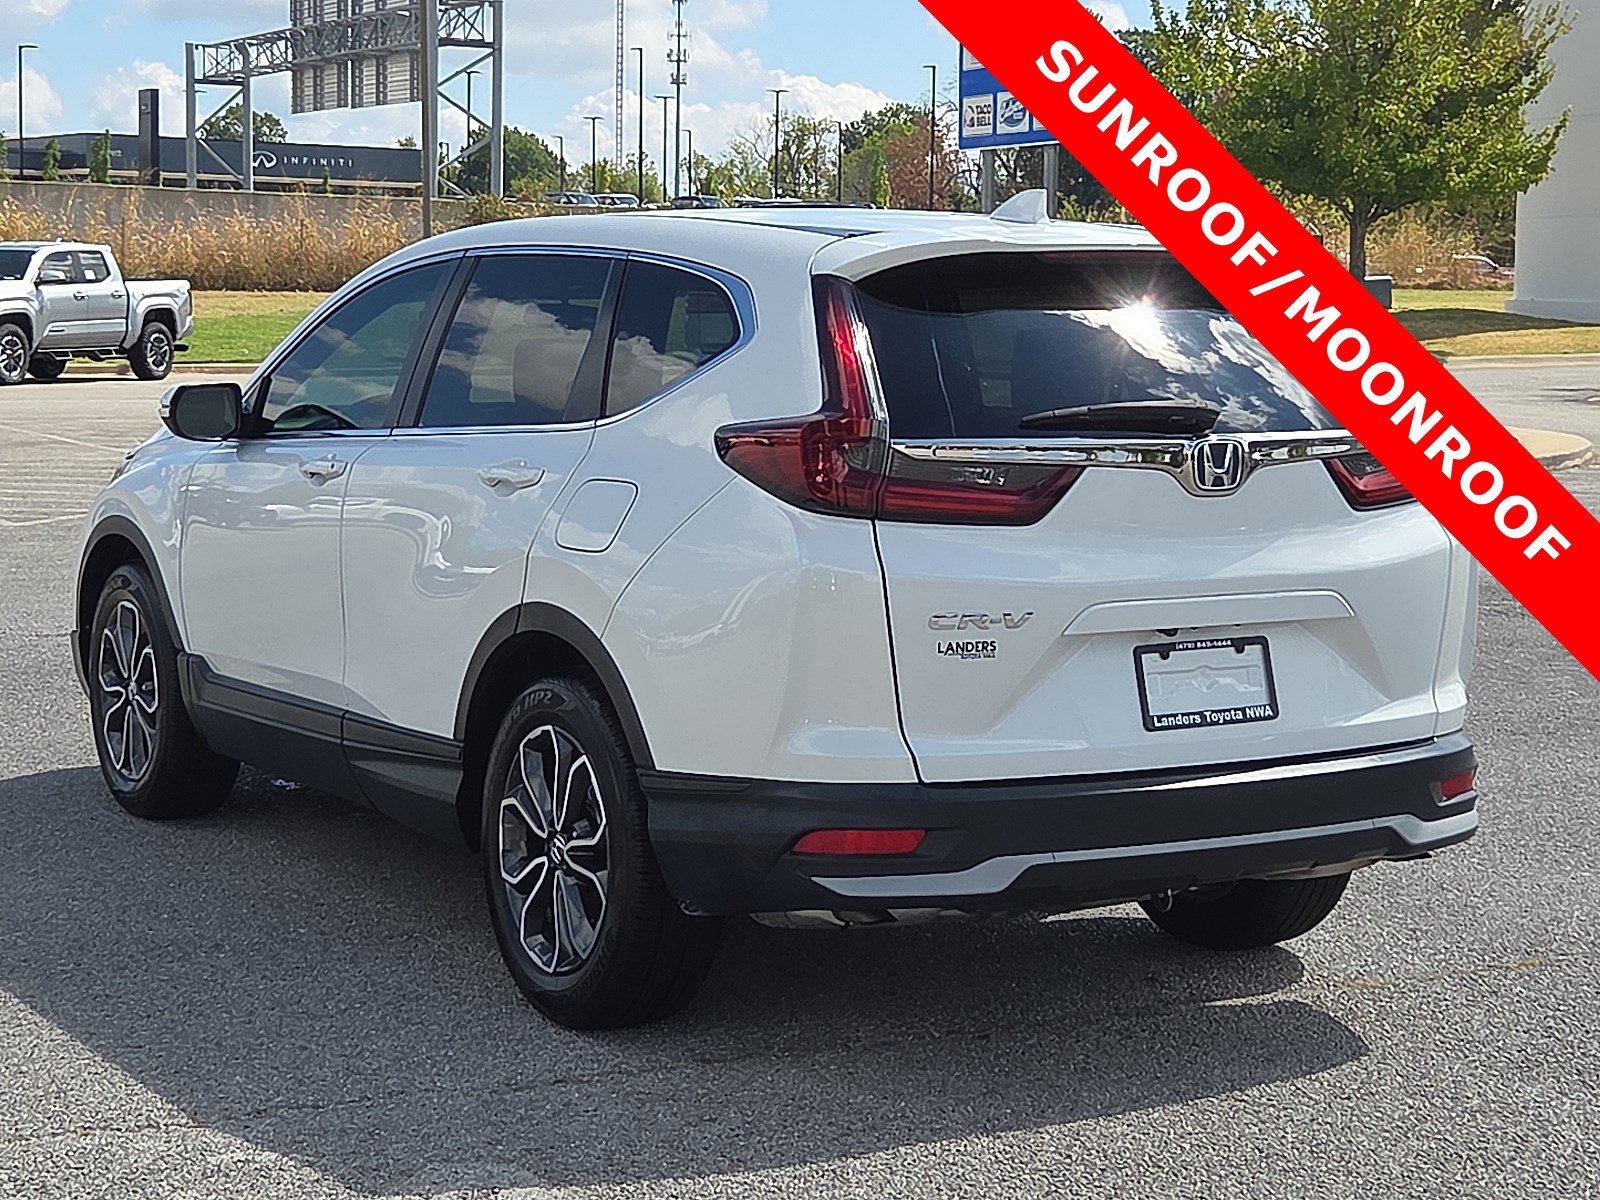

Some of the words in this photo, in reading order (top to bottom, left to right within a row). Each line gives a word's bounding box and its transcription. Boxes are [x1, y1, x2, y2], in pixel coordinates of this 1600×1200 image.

[975, 104, 992, 115] TACO
[976, 116, 992, 127] BELL
[283, 156, 354, 168] INFINITI
[928, 611, 1034, 630] CR-V
[937, 640, 997, 656] LANDERS
[1203, 709, 1243, 723] Toyota
[1245, 705, 1274, 719] NWA
